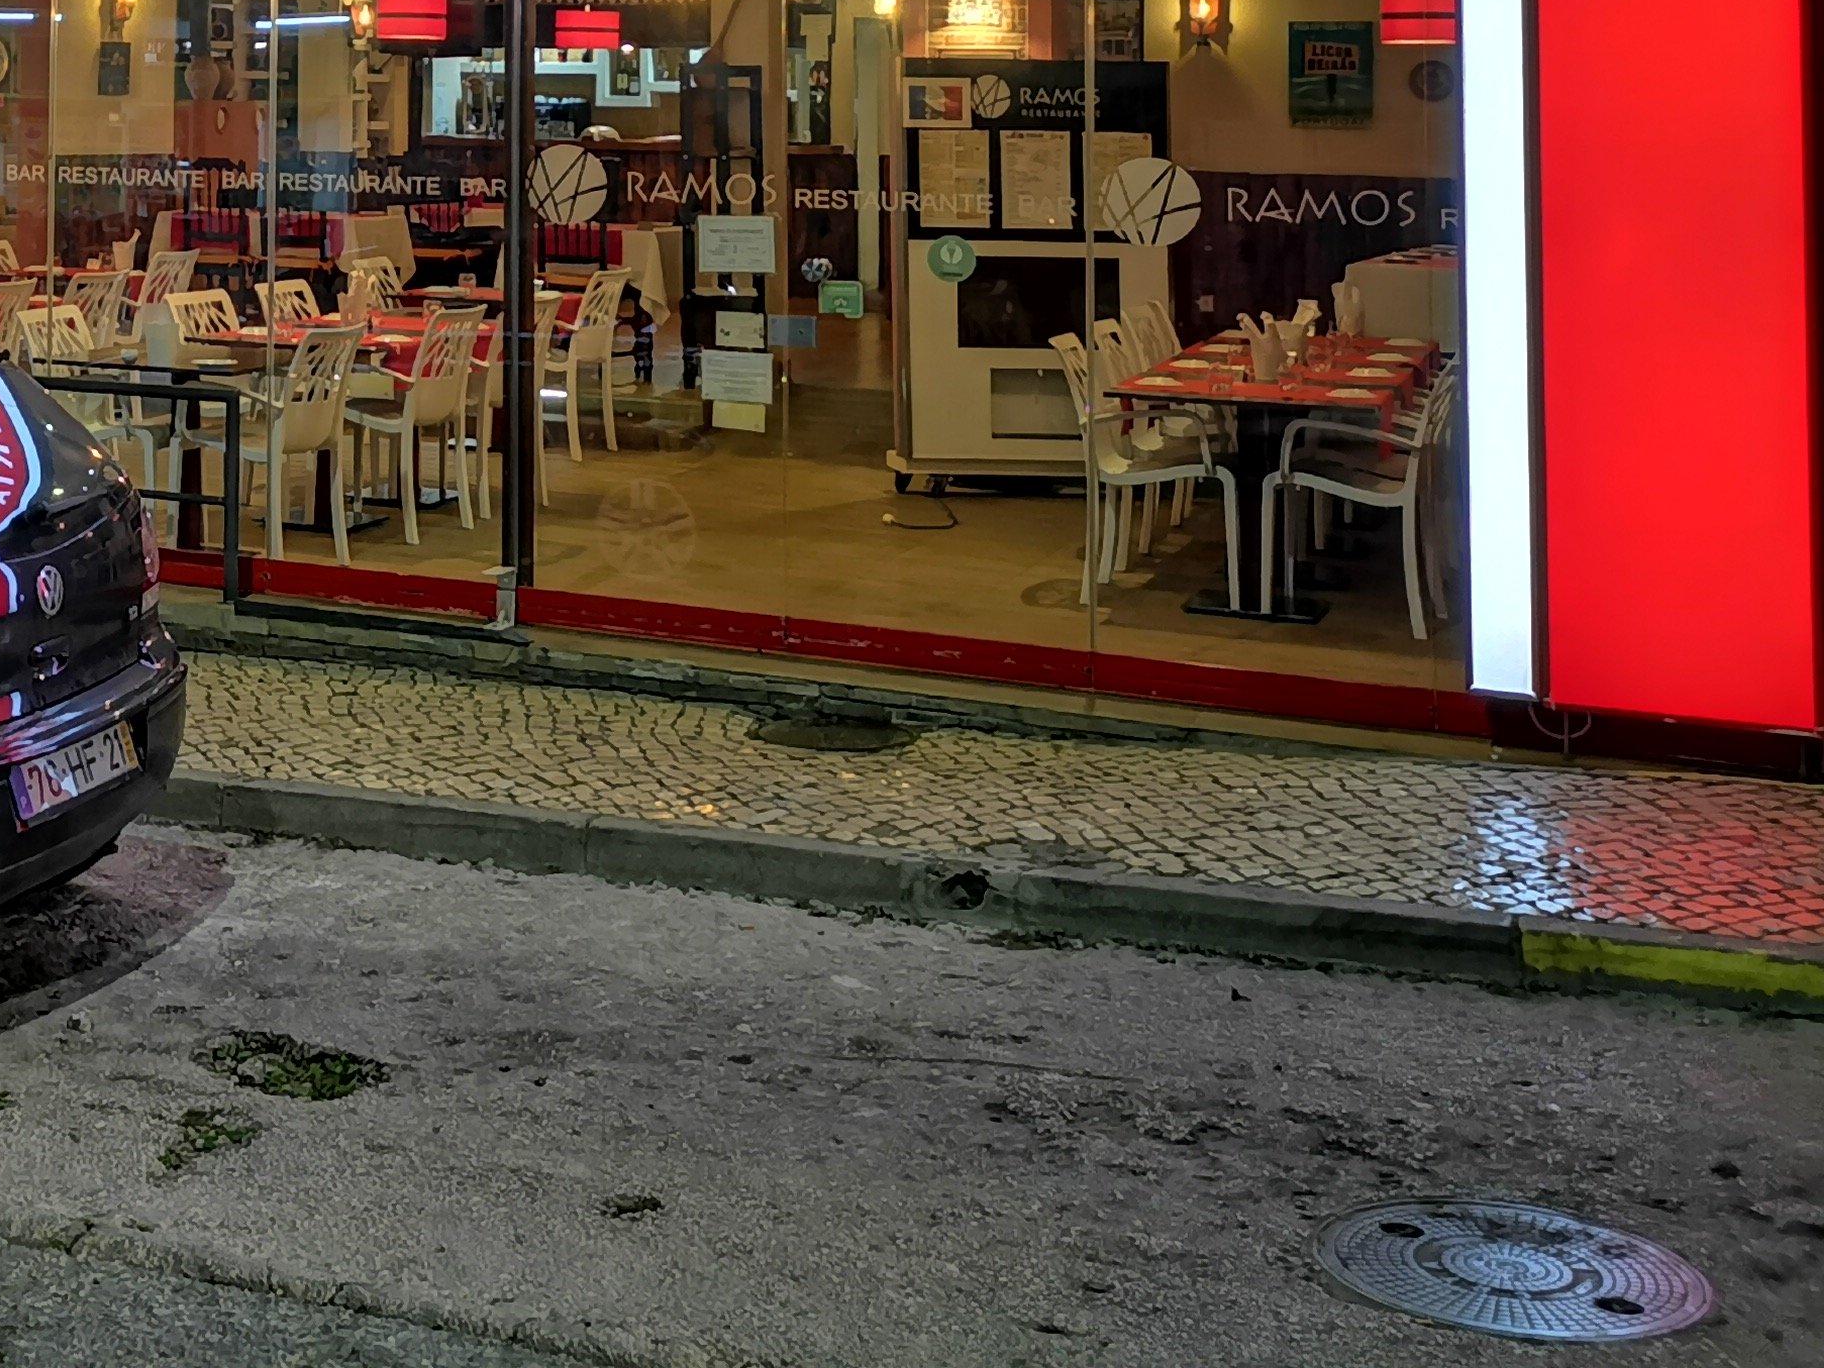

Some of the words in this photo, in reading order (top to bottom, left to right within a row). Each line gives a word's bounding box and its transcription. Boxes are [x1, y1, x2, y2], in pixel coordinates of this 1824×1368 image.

[6, 164, 45, 183] BAR
[58, 166, 205, 189] RESTAURANTE
[221, 171, 265, 191] BAR
[279, 172, 442, 196] RESTAURANTE
[459, 177, 508, 198] BAR
[626, 170, 777, 206] RAMOS
[794, 188, 994, 216] RESTAURANTE
[1018, 193, 1079, 218] BAR
[1226, 187, 1417, 228] RAMOS
